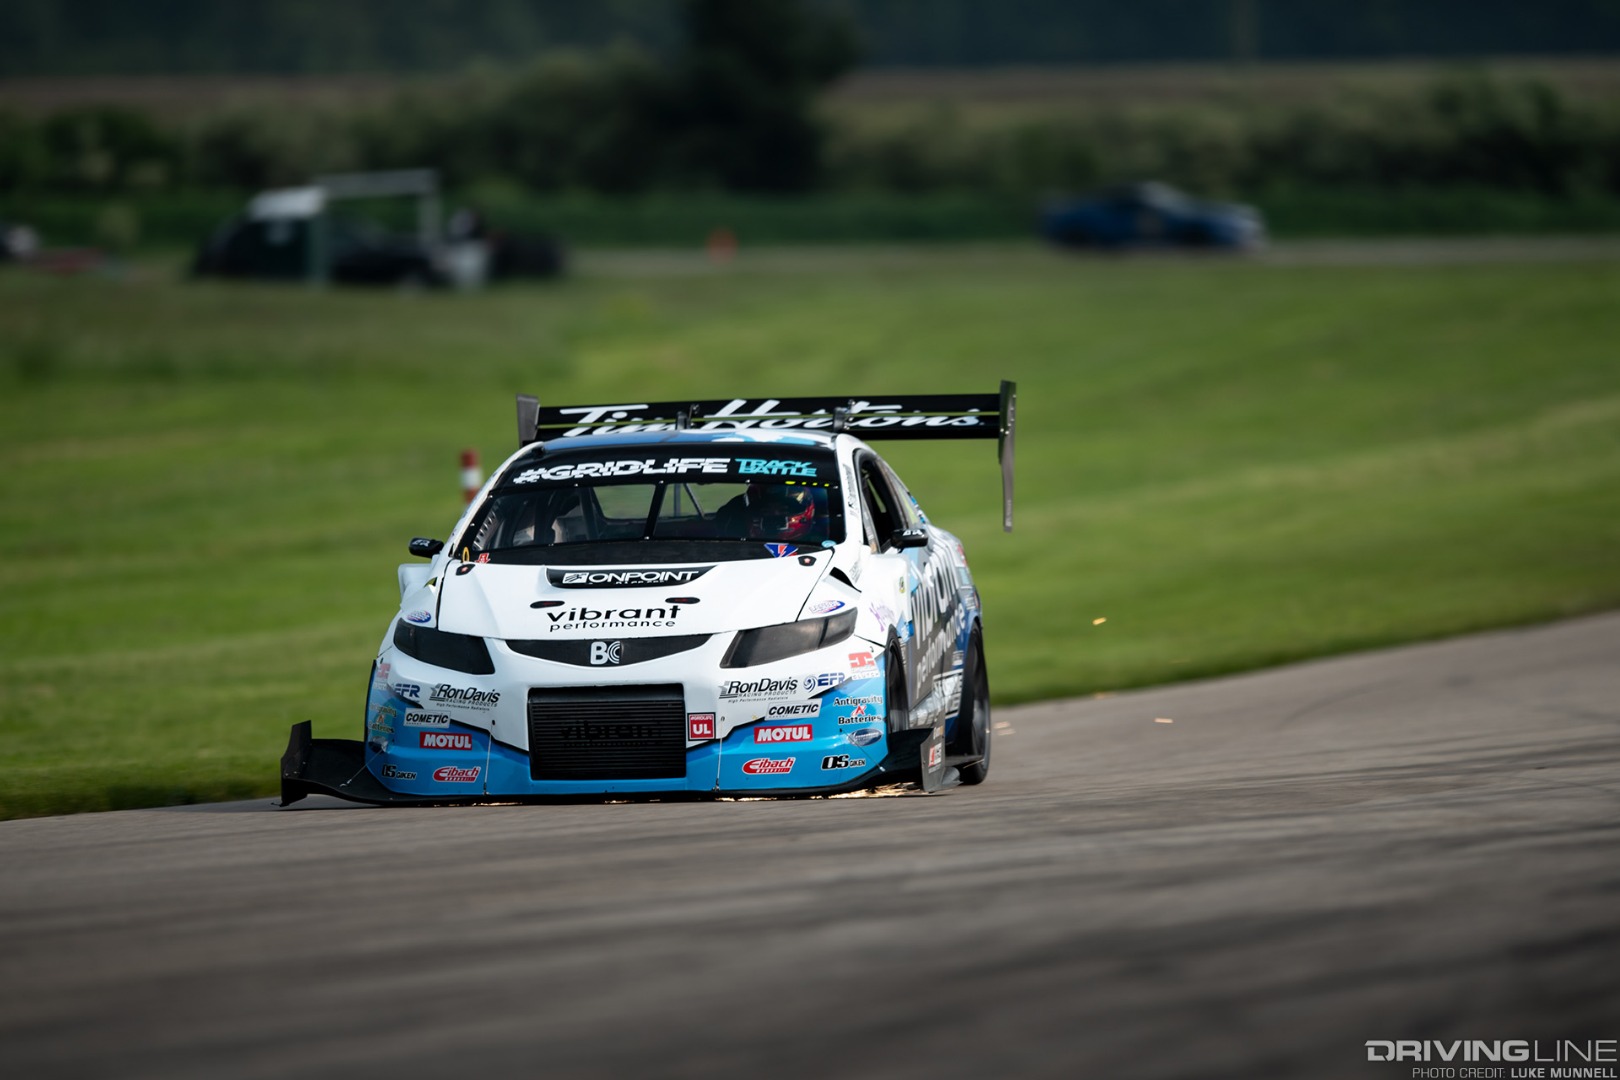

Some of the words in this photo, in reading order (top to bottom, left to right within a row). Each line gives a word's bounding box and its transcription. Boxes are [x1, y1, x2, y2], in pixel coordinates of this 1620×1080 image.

[513, 458, 731, 484] #GRIDLIFE
[589, 571, 699, 583] ONPOINT
[547, 605, 681, 622] vibrant
[549, 620, 676, 632] performance
[834, 696, 883, 706] Antigravity
[768, 703, 819, 716] COMETIC
[406, 713, 449, 724] COMETIC
[838, 714, 882, 725] Batteries
[692, 723, 712, 735] UL
[757, 727, 811, 742] MOTUL
[423, 734, 472, 749] MOTUL
[742, 758, 796, 774] Eibach
[433, 766, 481, 782] Eibach
